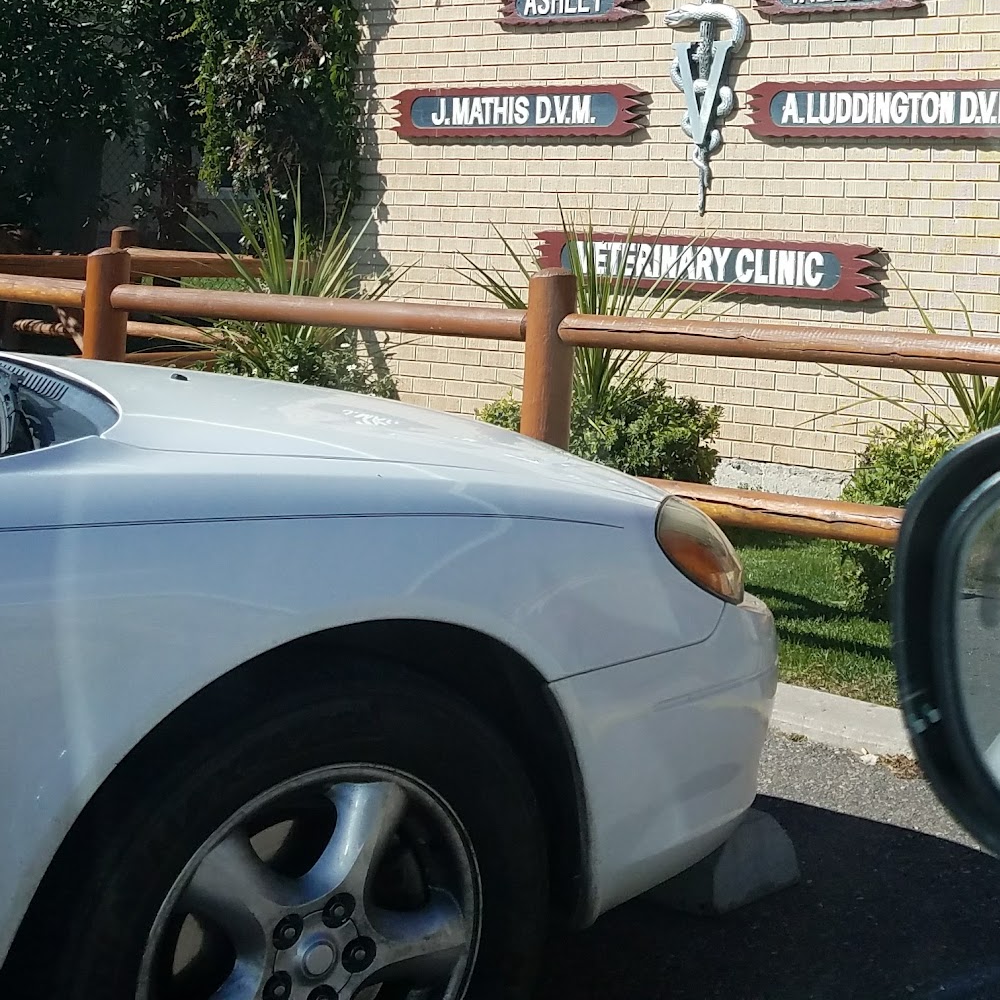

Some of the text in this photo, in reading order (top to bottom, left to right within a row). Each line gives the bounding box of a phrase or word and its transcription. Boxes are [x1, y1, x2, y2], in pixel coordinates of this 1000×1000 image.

[535, 94, 597, 125] D.V.M.
[576, 240, 825, 287] VETERINARY CLINIC
